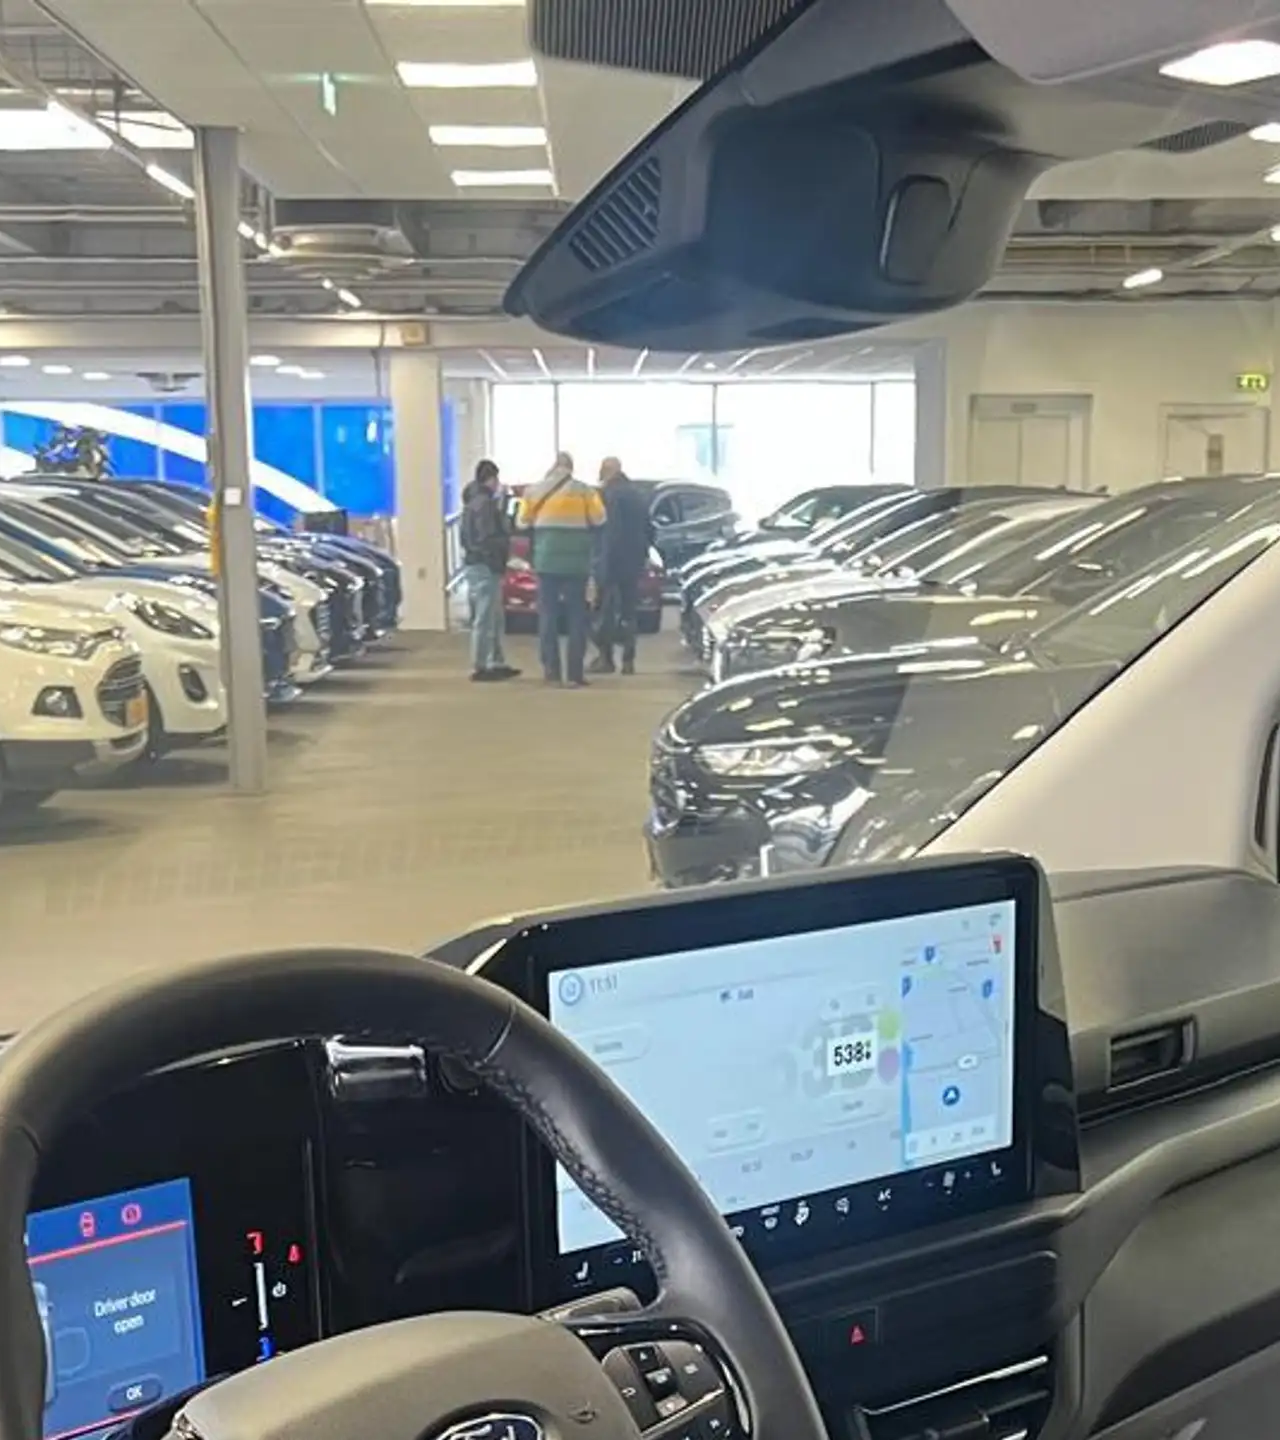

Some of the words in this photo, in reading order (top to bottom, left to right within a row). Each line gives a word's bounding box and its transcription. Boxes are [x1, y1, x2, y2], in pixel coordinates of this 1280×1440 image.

[94, 1296, 130, 1318] Driver
[130, 1288, 157, 1308] door
[114, 1315, 144, 1334] open
[126, 1384, 143, 1400] OK
